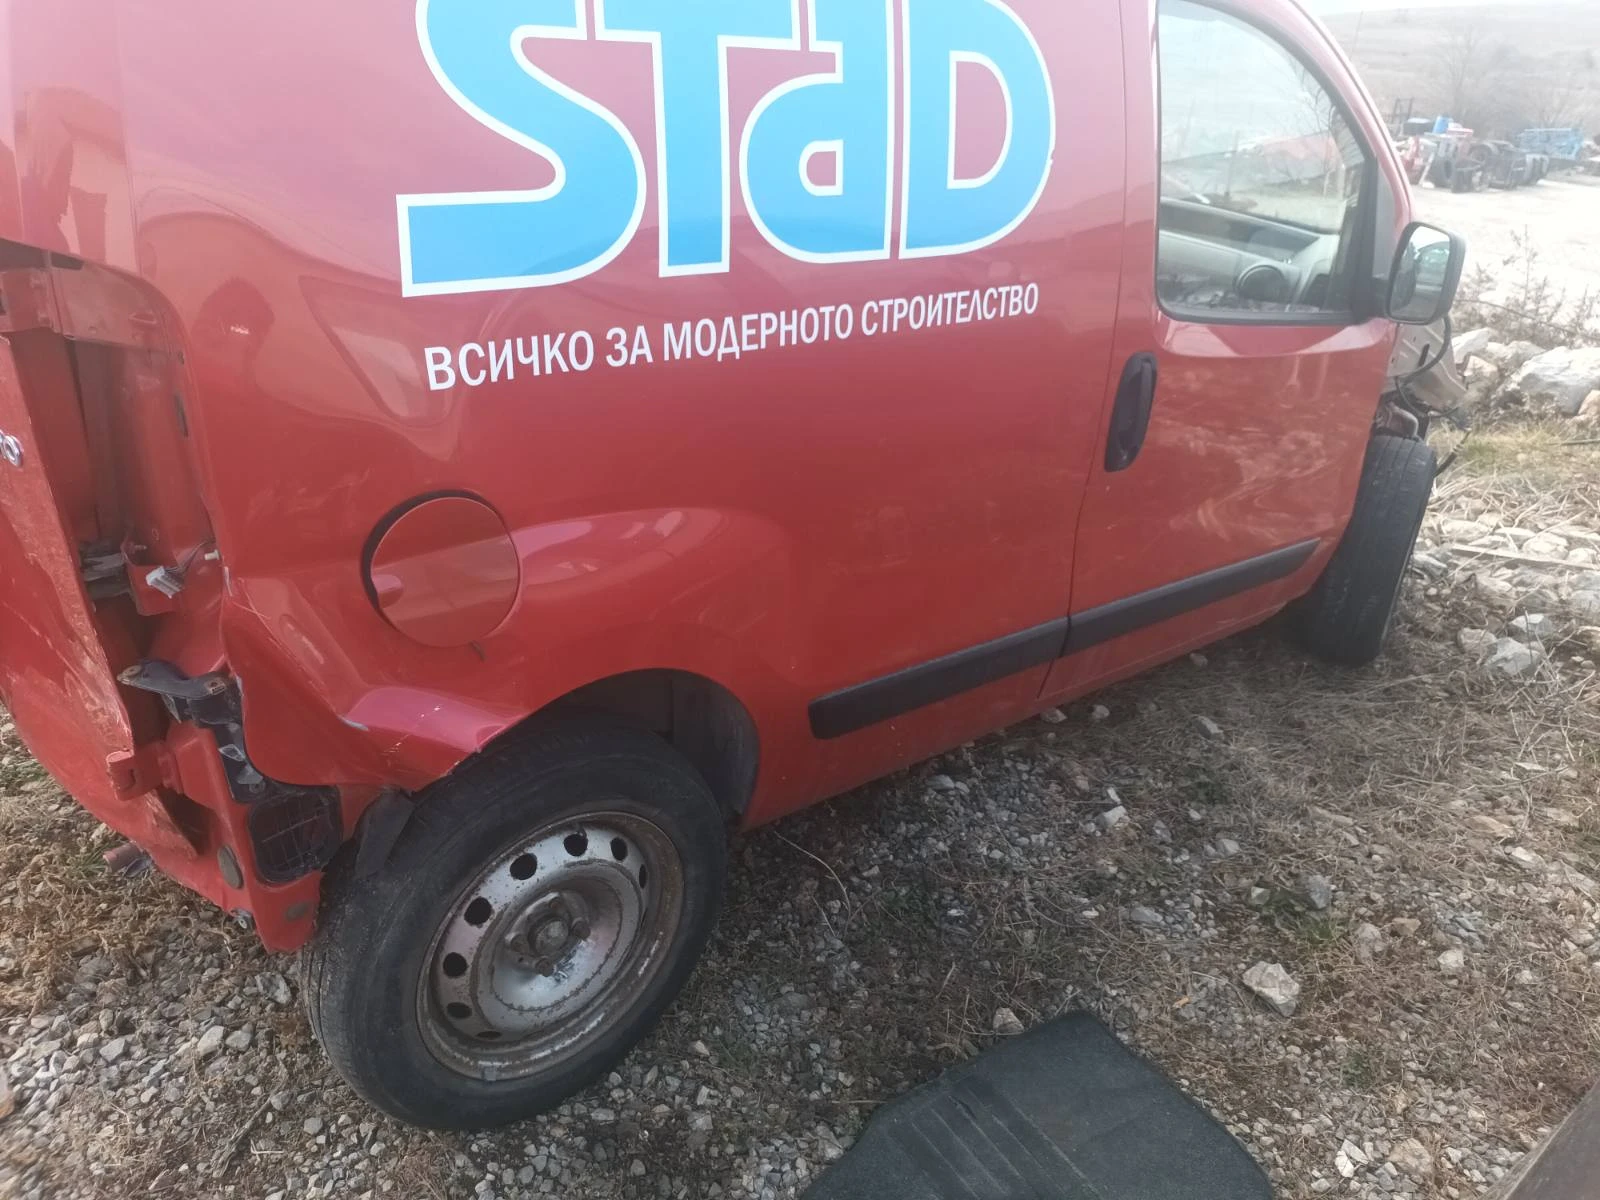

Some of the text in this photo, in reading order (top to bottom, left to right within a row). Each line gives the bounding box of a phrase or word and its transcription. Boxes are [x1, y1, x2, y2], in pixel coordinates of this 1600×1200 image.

[424, 282, 1040, 391] ВСИЧКО ЗА МОДЕРНОТО СТРОИТЕЛСТВО
